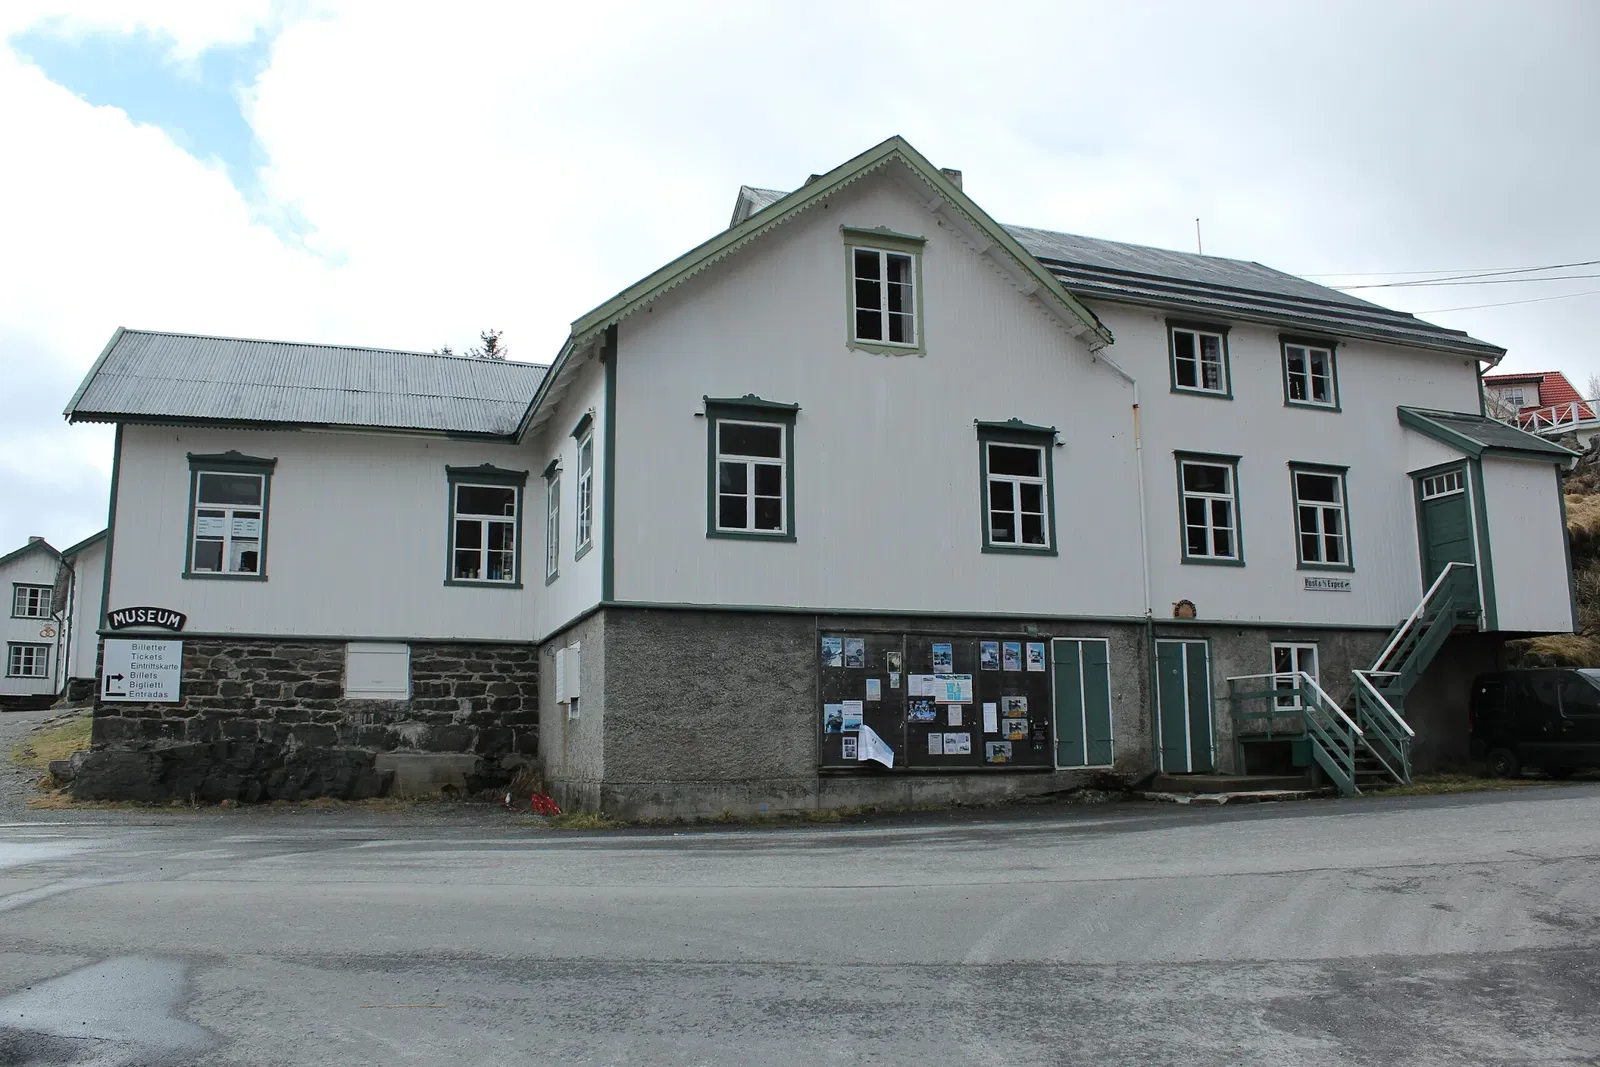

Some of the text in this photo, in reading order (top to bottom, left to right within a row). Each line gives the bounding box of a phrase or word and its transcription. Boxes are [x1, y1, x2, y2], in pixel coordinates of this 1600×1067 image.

[113, 610, 181, 628] MUSEUM
[131, 643, 167, 651] Billetter
[130, 662, 179, 670] Eintrittskarte
[129, 681, 164, 690] Biglietti
